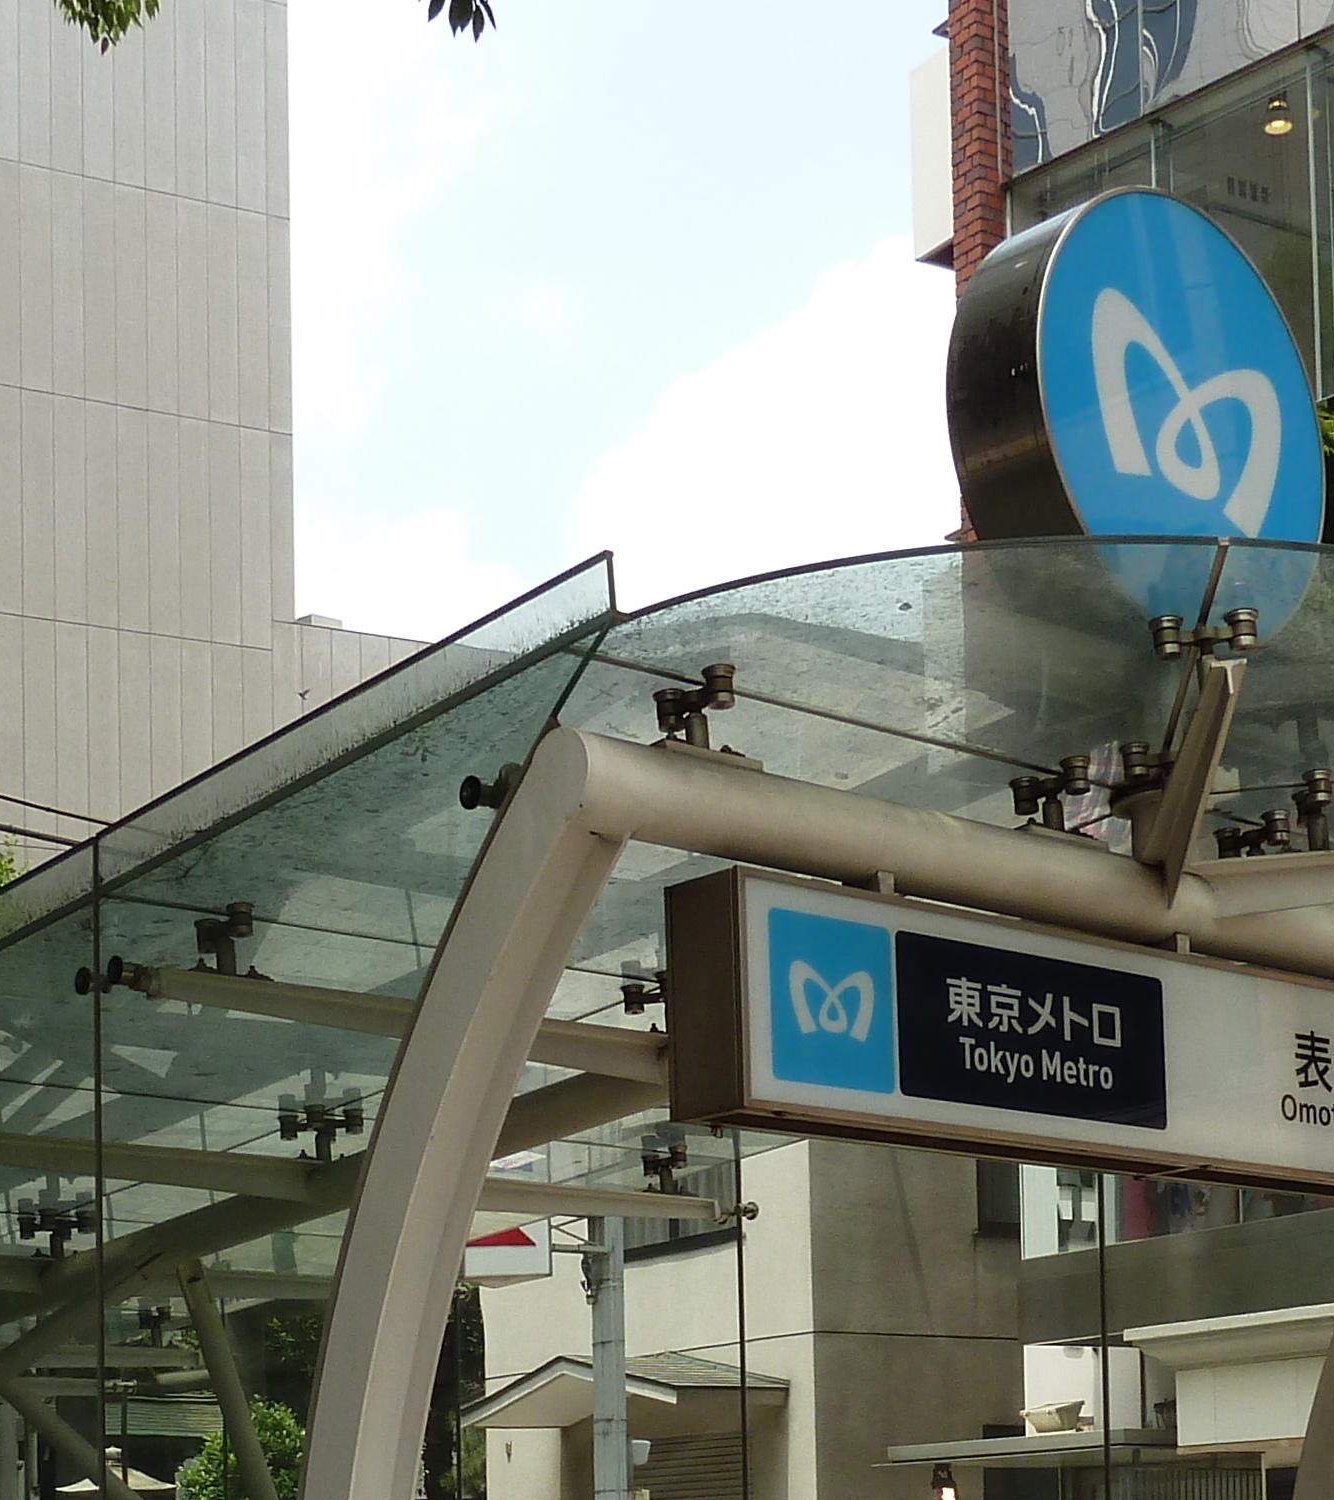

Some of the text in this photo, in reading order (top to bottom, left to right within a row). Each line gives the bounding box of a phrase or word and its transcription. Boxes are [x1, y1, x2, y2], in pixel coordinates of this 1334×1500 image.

[945, 975, 1123, 1048] 東京メトロ
[958, 1036, 1114, 1091] Tokyo Metro
